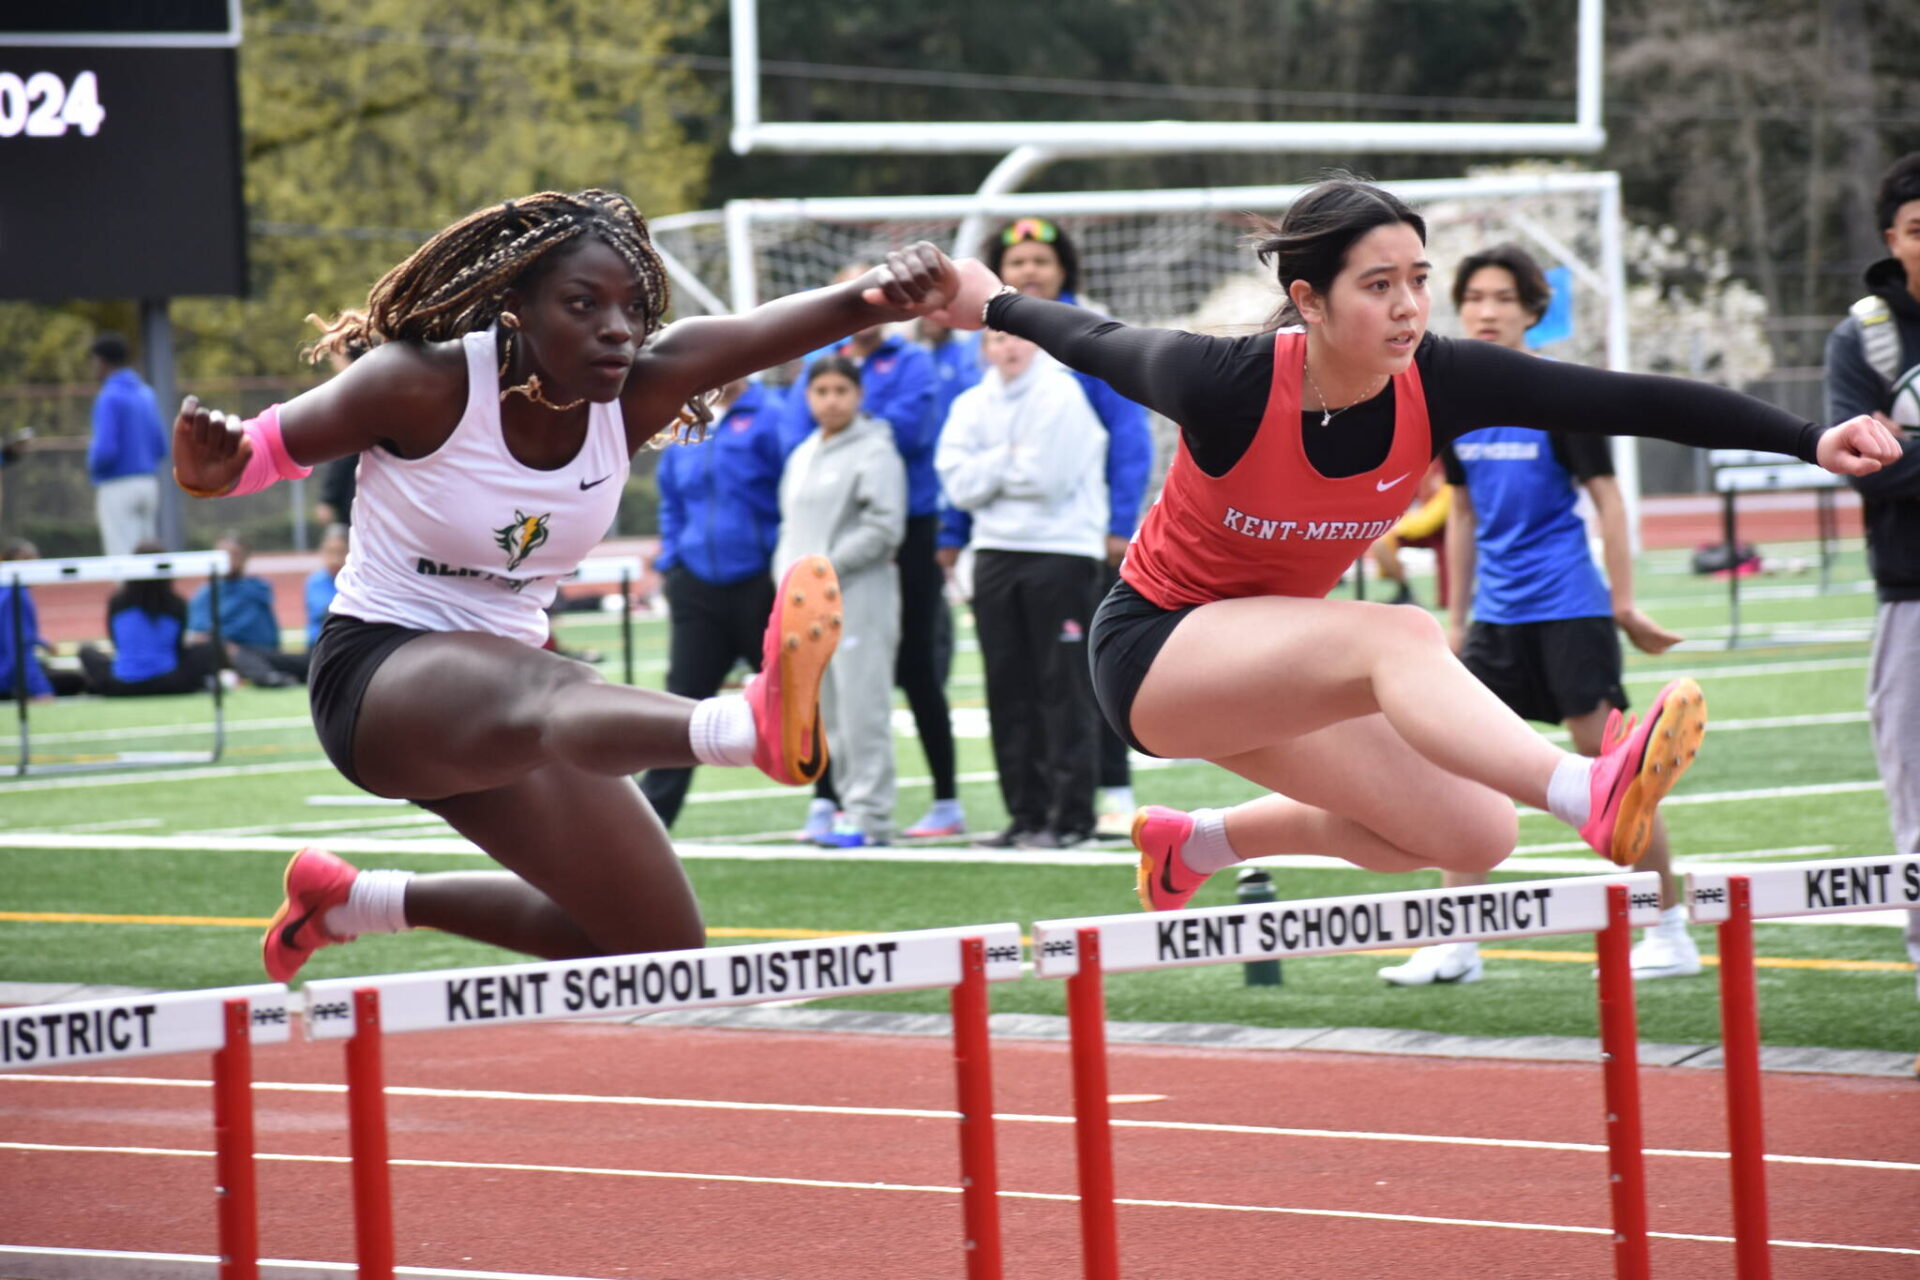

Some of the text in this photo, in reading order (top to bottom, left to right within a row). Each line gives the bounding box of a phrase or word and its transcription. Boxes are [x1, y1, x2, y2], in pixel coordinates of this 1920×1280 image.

[0, 70, 106, 137] 024
[1222, 507, 1401, 541] KENT-MERIDI
[1807, 865, 1890, 909] KENT
[1157, 888, 1552, 961] KENT SCHOOL DISTRICT
[447, 942, 898, 1022] KENT SCHOOL DISTRICT
